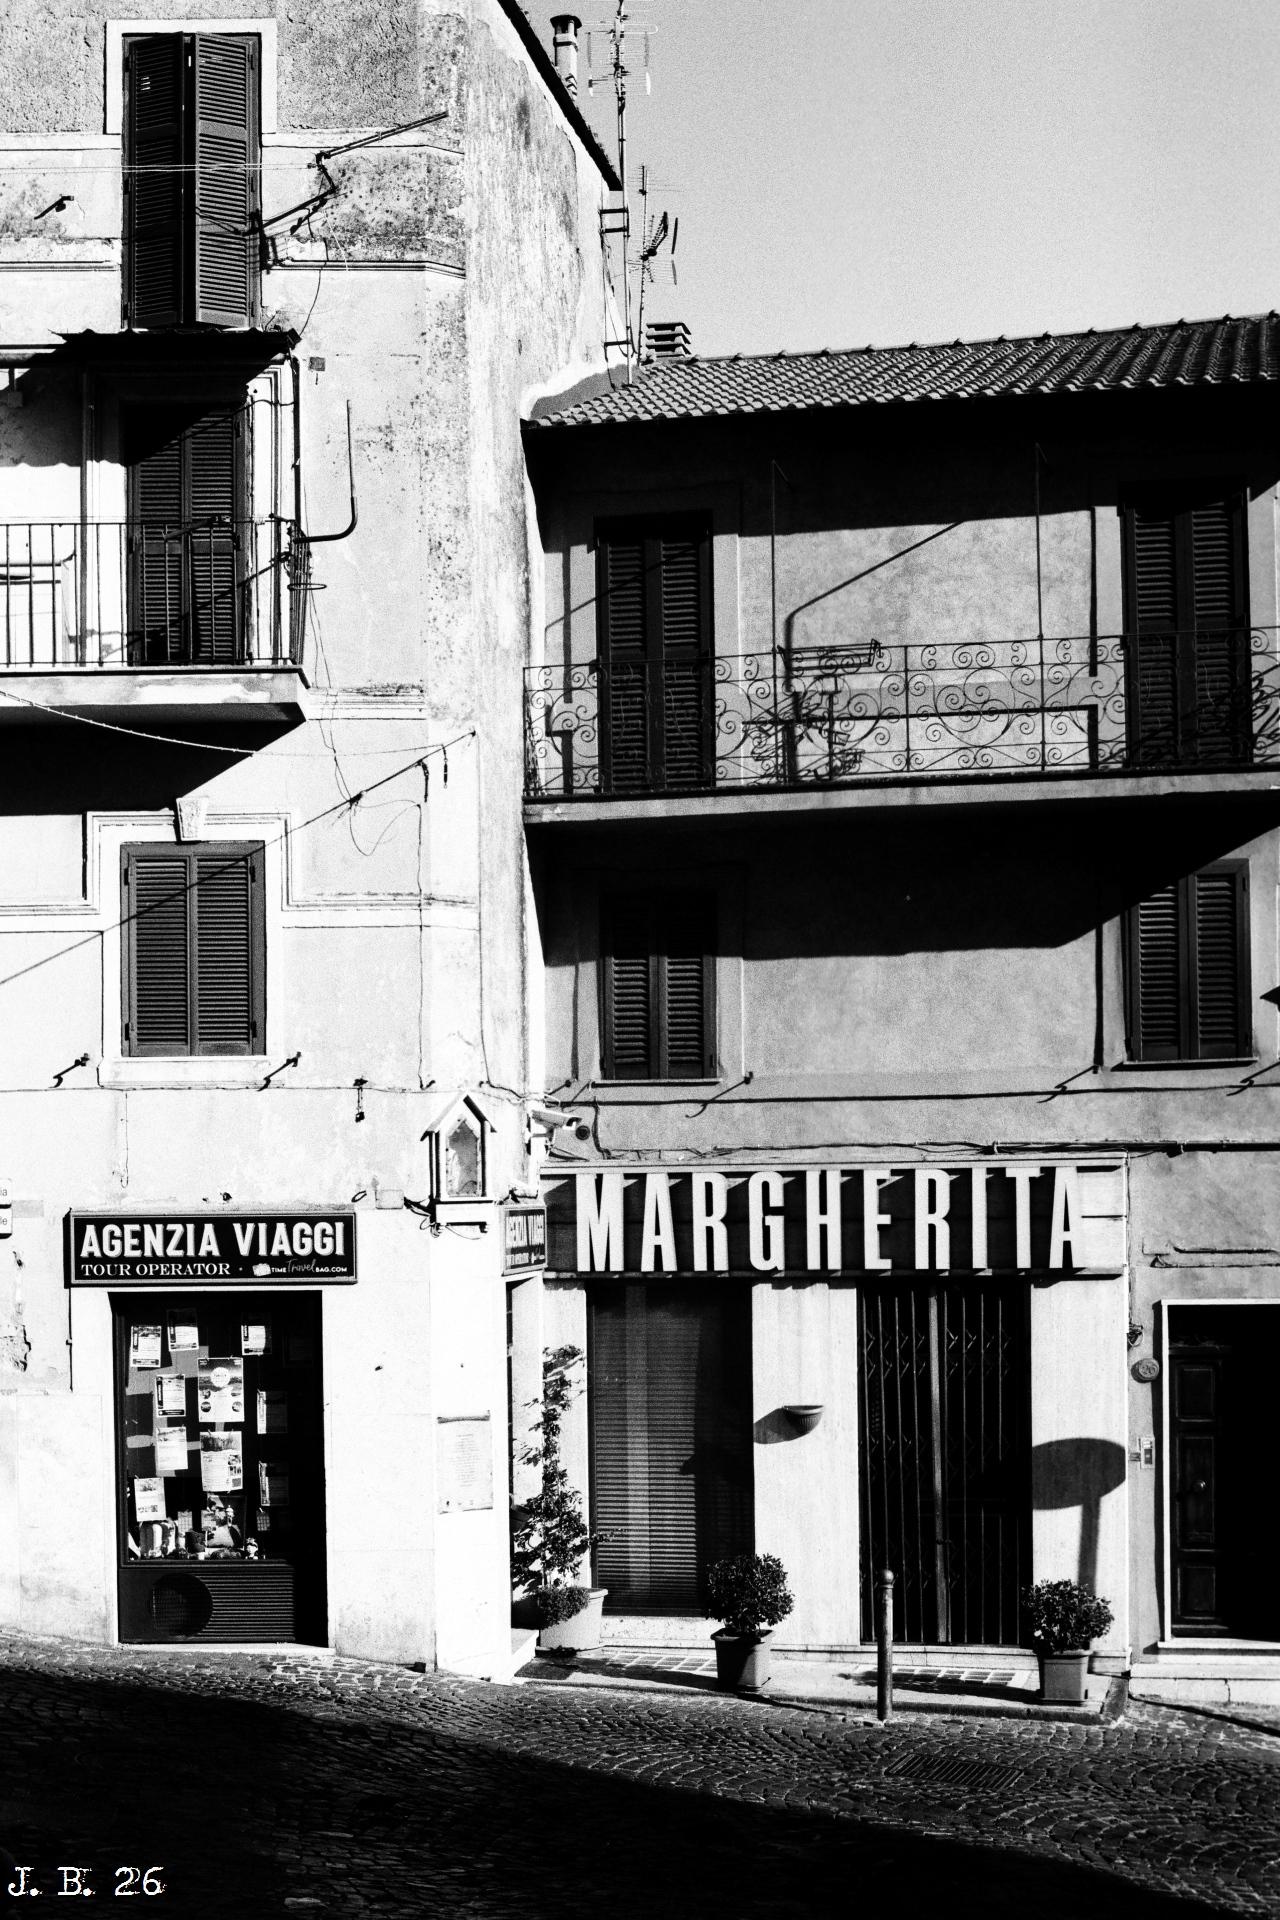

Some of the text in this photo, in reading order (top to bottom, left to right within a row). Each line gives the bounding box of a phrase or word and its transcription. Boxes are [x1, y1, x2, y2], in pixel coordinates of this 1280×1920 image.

[576, 1166, 1083, 1273] MARGHERITA
[80, 1221, 345, 1258] AGENZIA VIAGGI
[81, 1262, 231, 1277] TOUR OPERATOR
